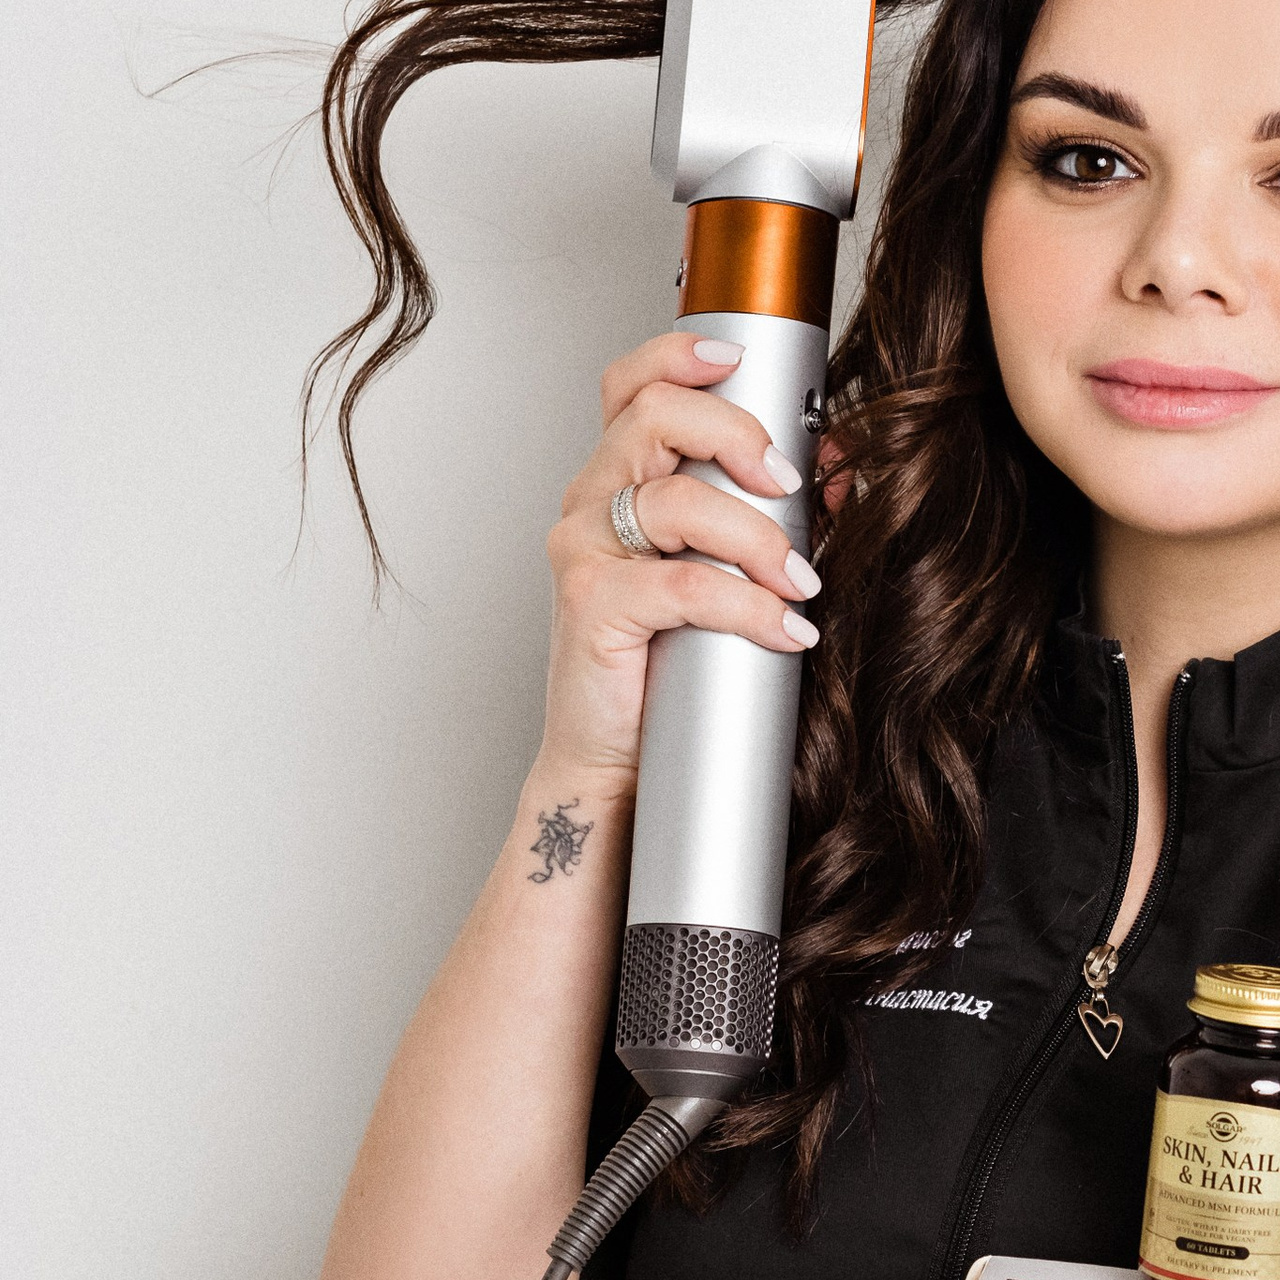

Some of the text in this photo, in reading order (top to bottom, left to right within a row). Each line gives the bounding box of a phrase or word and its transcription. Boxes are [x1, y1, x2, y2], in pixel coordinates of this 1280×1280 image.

[1205, 1120, 1243, 1134] SOLGAR
[1163, 1135, 1212, 1169] SKIN,
[1178, 1165, 1263, 1196] & HAIR
[1159, 1189, 1206, 1209] ADVANCED
[1207, 1201, 1232, 1214] MSM
[1192, 1221, 1219, 1233] WHEAT
[1228, 1227, 1252, 1237] DAIRY
[1253, 1229, 1272, 1238] FREE
[1209, 1231, 1225, 1240] FOR
[1225, 1234, 1257, 1244] VEGANS
[1186, 1241, 1237, 1258] 60 TABLETS
[1166, 1255, 1259, 1277] DIETARY SUPPLEMENT
